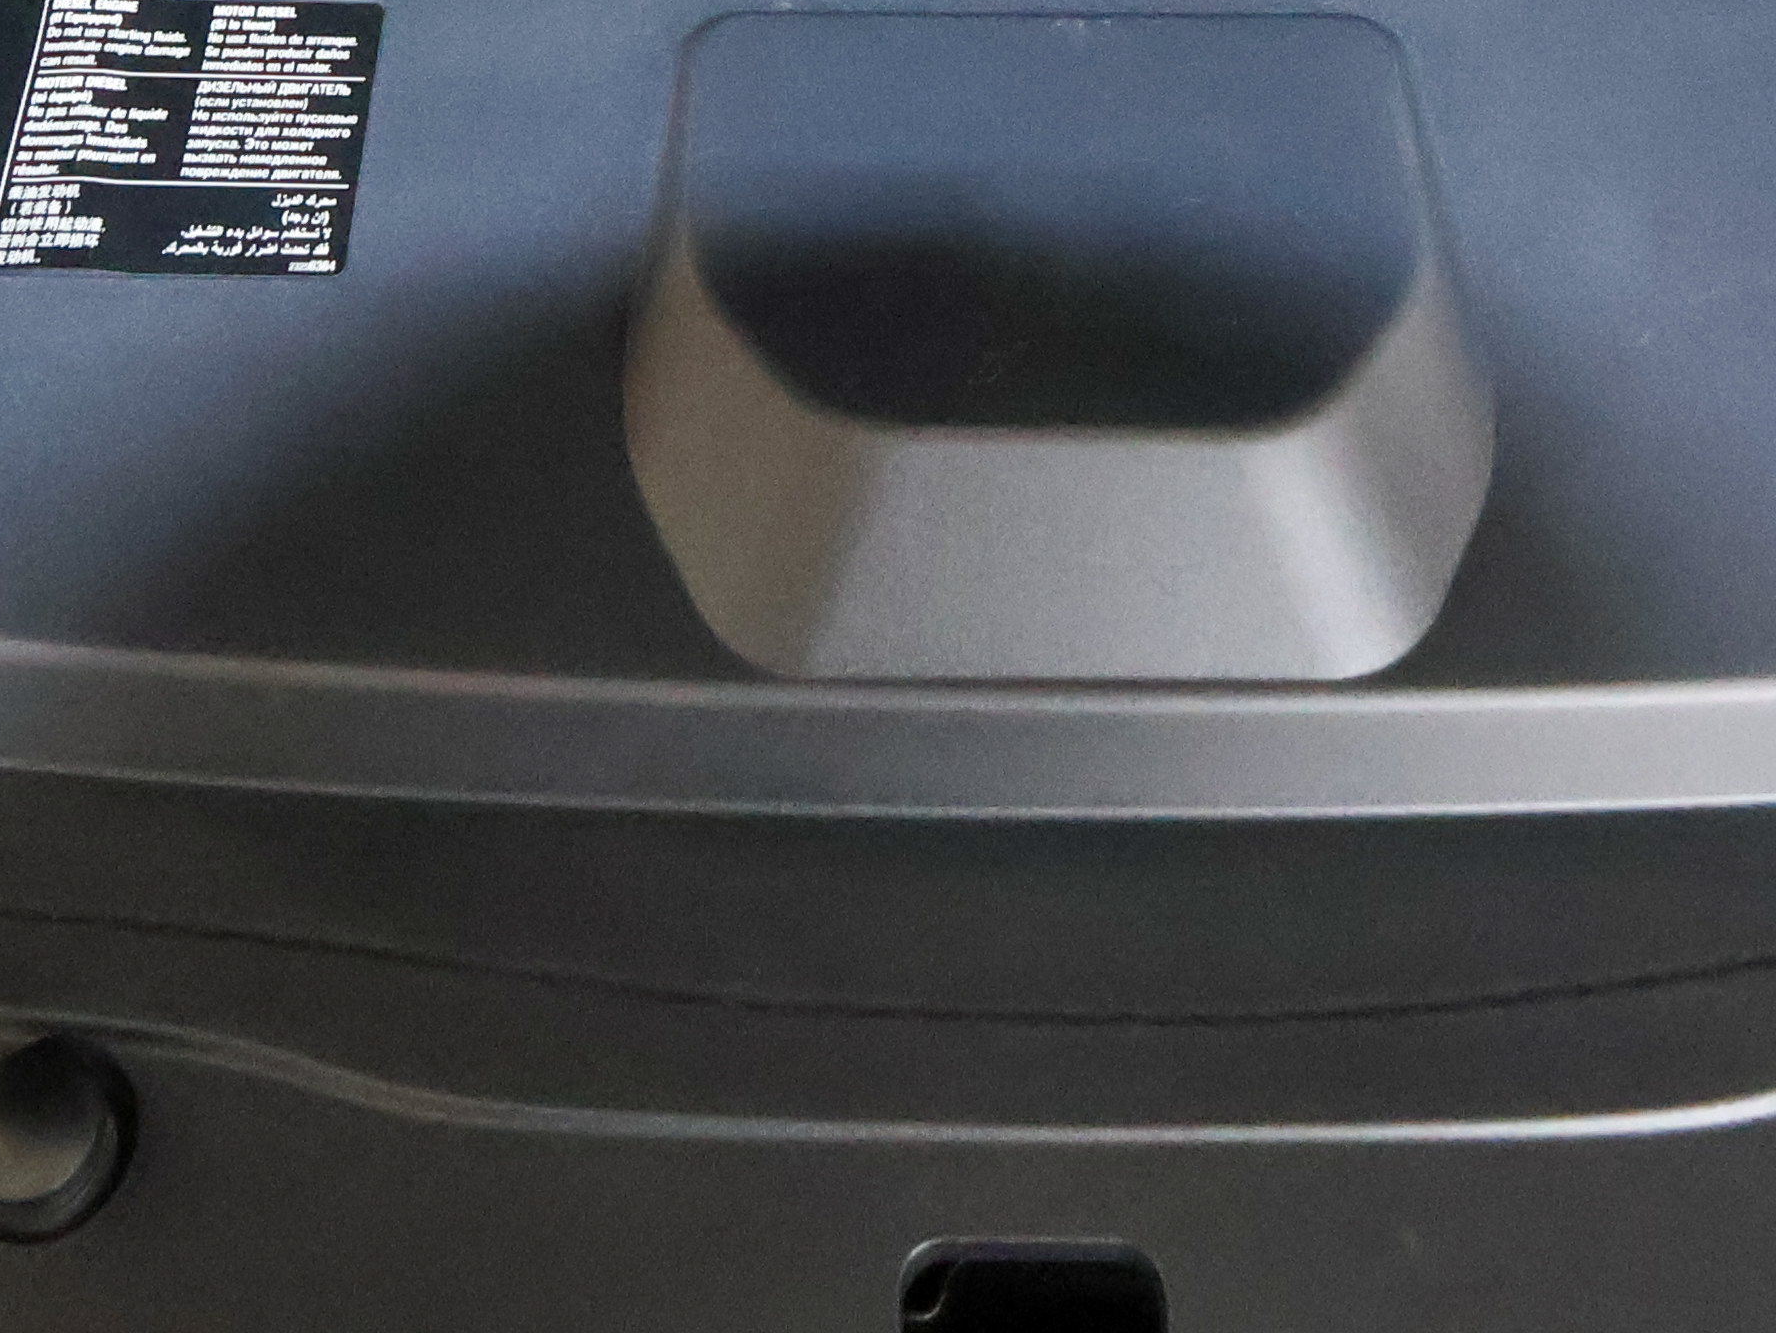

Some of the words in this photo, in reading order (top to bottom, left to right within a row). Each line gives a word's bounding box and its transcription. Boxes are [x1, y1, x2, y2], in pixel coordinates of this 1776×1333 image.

[95, 0, 139, 13] ENGINE
[213, 5, 255, 17] MOTOR
[257, 6, 297, 18] DIESEL
[64, 12, 123, 26] Equipped)
[210, 18, 226, 31] (Si
[242, 20, 276, 32] tiene)
[46, 27, 62, 38] Do
[63, 26, 83, 36] not
[84, 28, 106, 37] use
[107, 28, 151, 43] starting
[153, 30, 187, 43] fluids.
[207, 32, 224, 44] No
[225, 34, 247, 44] use
[249, 33, 287, 45] fluidos
[288, 35, 304, 45] de
[306, 36, 358, 48] arranque.
[103, 43, 143, 55] engine
[144, 43, 191, 59] damage
[205, 45, 221, 58] Se
[221, 47, 264, 59] pueden
[266, 47, 314, 60] producir
[315, 48, 350, 60] daños
[40, 56, 61, 66] can
[62, 54, 97, 66] result.
[266, 62, 281, 72] en
[283, 62, 295, 72] el
[296, 63, 332, 73] motor.
[34, 76, 84, 89] MOTEUR
[85, 76, 127, 91] DIESEL
[196, 81, 277, 94] ДИЗЕЛЬНЫЙ
[277, 82, 352, 96] ДВИГАТЕЛЬ
[31, 91, 48, 105] (si
[194, 96, 229, 108] (если
[231, 97, 308, 111] установлен)
[27, 105, 45, 117] Ne
[45, 106, 68, 119] pas
[69, 104, 110, 118] utiliser
[111, 107, 127, 119] de
[128, 108, 169, 121] liquide
[192, 109, 210, 121] Не
[211, 111, 294, 125] используйте
[295, 114, 358, 126] пусковые
[104, 120, 128, 134] Des
[188, 126, 253, 137] жидкости
[254, 127, 280, 137] для
[281, 128, 351, 138] холодного
[20, 134, 84, 147] dommages
[86, 133, 148, 149] immédiats
[186, 139, 241, 151] запуска.
[244, 138, 269, 150] Это
[271, 141, 315, 151] может
[16, 151, 33, 161] au
[34, 149, 77, 161] moteur
[76, 149, 139, 163] pourraient
[140, 153, 157, 163] en
[183, 152, 238, 164] вызвать
[239, 154, 328, 166] немедленное
[13, 163, 60, 176] résulter.
[271, 168, 342, 181] двигателя.
[323, 227, 332, 240] لا
